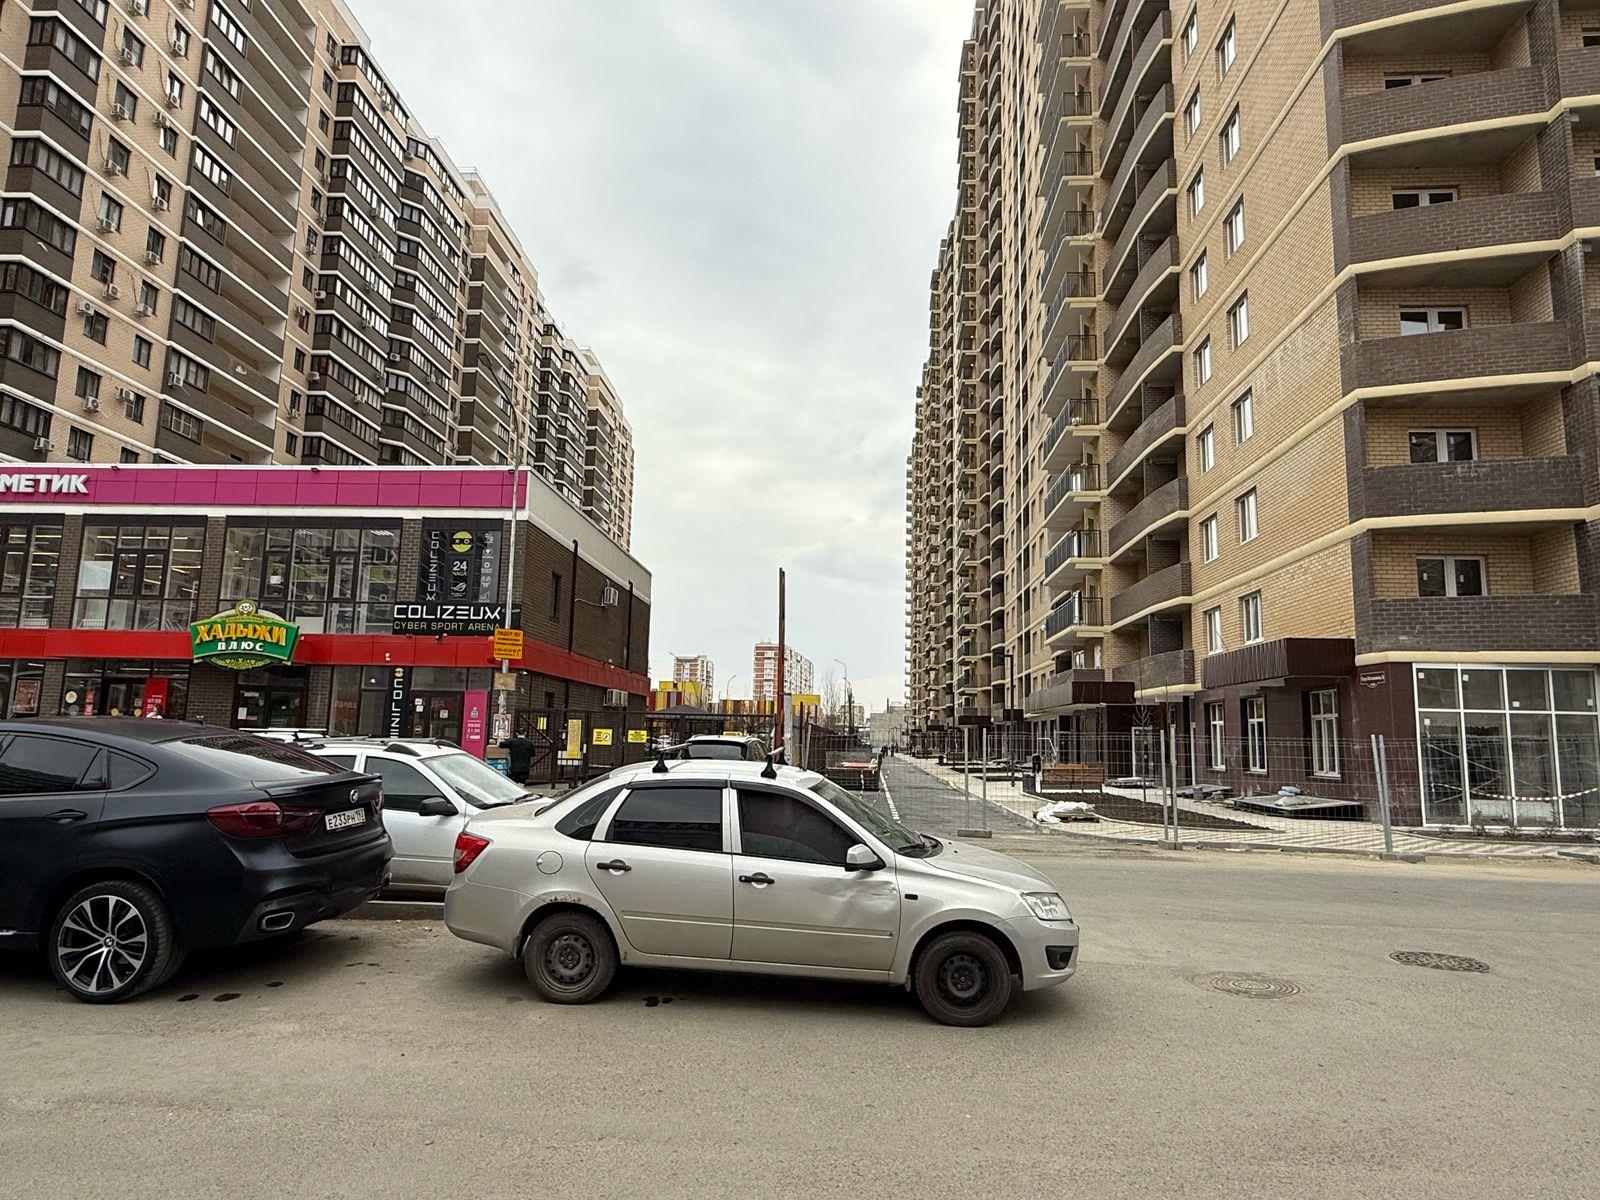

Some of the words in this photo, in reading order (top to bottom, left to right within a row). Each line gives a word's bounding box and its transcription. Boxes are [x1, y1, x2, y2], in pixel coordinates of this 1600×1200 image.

[0, 473, 88, 494] МЕТИК
[452, 560, 468, 571] 24
[394, 604, 501, 620] COLIZEUM
[393, 621, 427, 630] CYBER
[430, 622, 464, 631] SPORT
[467, 622, 500, 632] ARENA
[194, 623, 287, 647] ХАДЫЖИ
[217, 641, 264, 651] ПЛЮС
[390, 678, 404, 739] COLIZE
